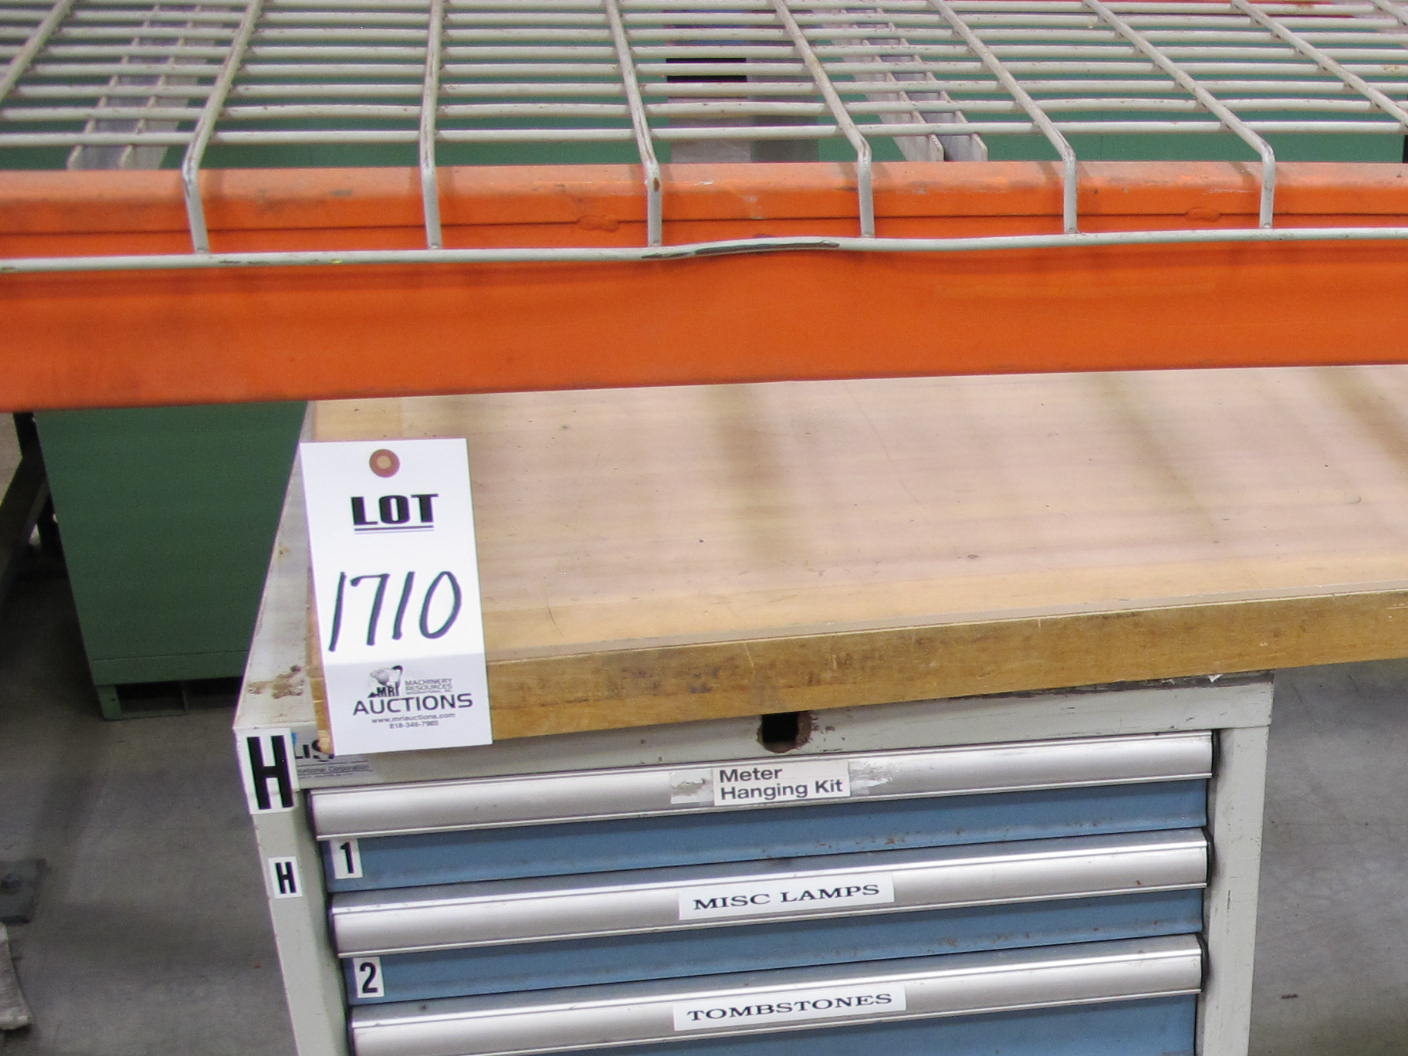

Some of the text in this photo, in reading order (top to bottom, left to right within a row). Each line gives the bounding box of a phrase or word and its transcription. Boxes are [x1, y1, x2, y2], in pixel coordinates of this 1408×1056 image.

[350, 493, 440, 526] LOT
[328, 571, 462, 652] 1710
[352, 693, 473, 716] AUCTIONS
[247, 735, 295, 810] H
[719, 768, 783, 784] Meter
[720, 779, 843, 800] Hanging Kit
[340, 842, 354, 874] 1
[275, 861, 297, 894] H
[693, 884, 881, 910] MISC LAMPS
[359, 961, 378, 994] 2
[687, 993, 894, 1022] TOMBSTONES
